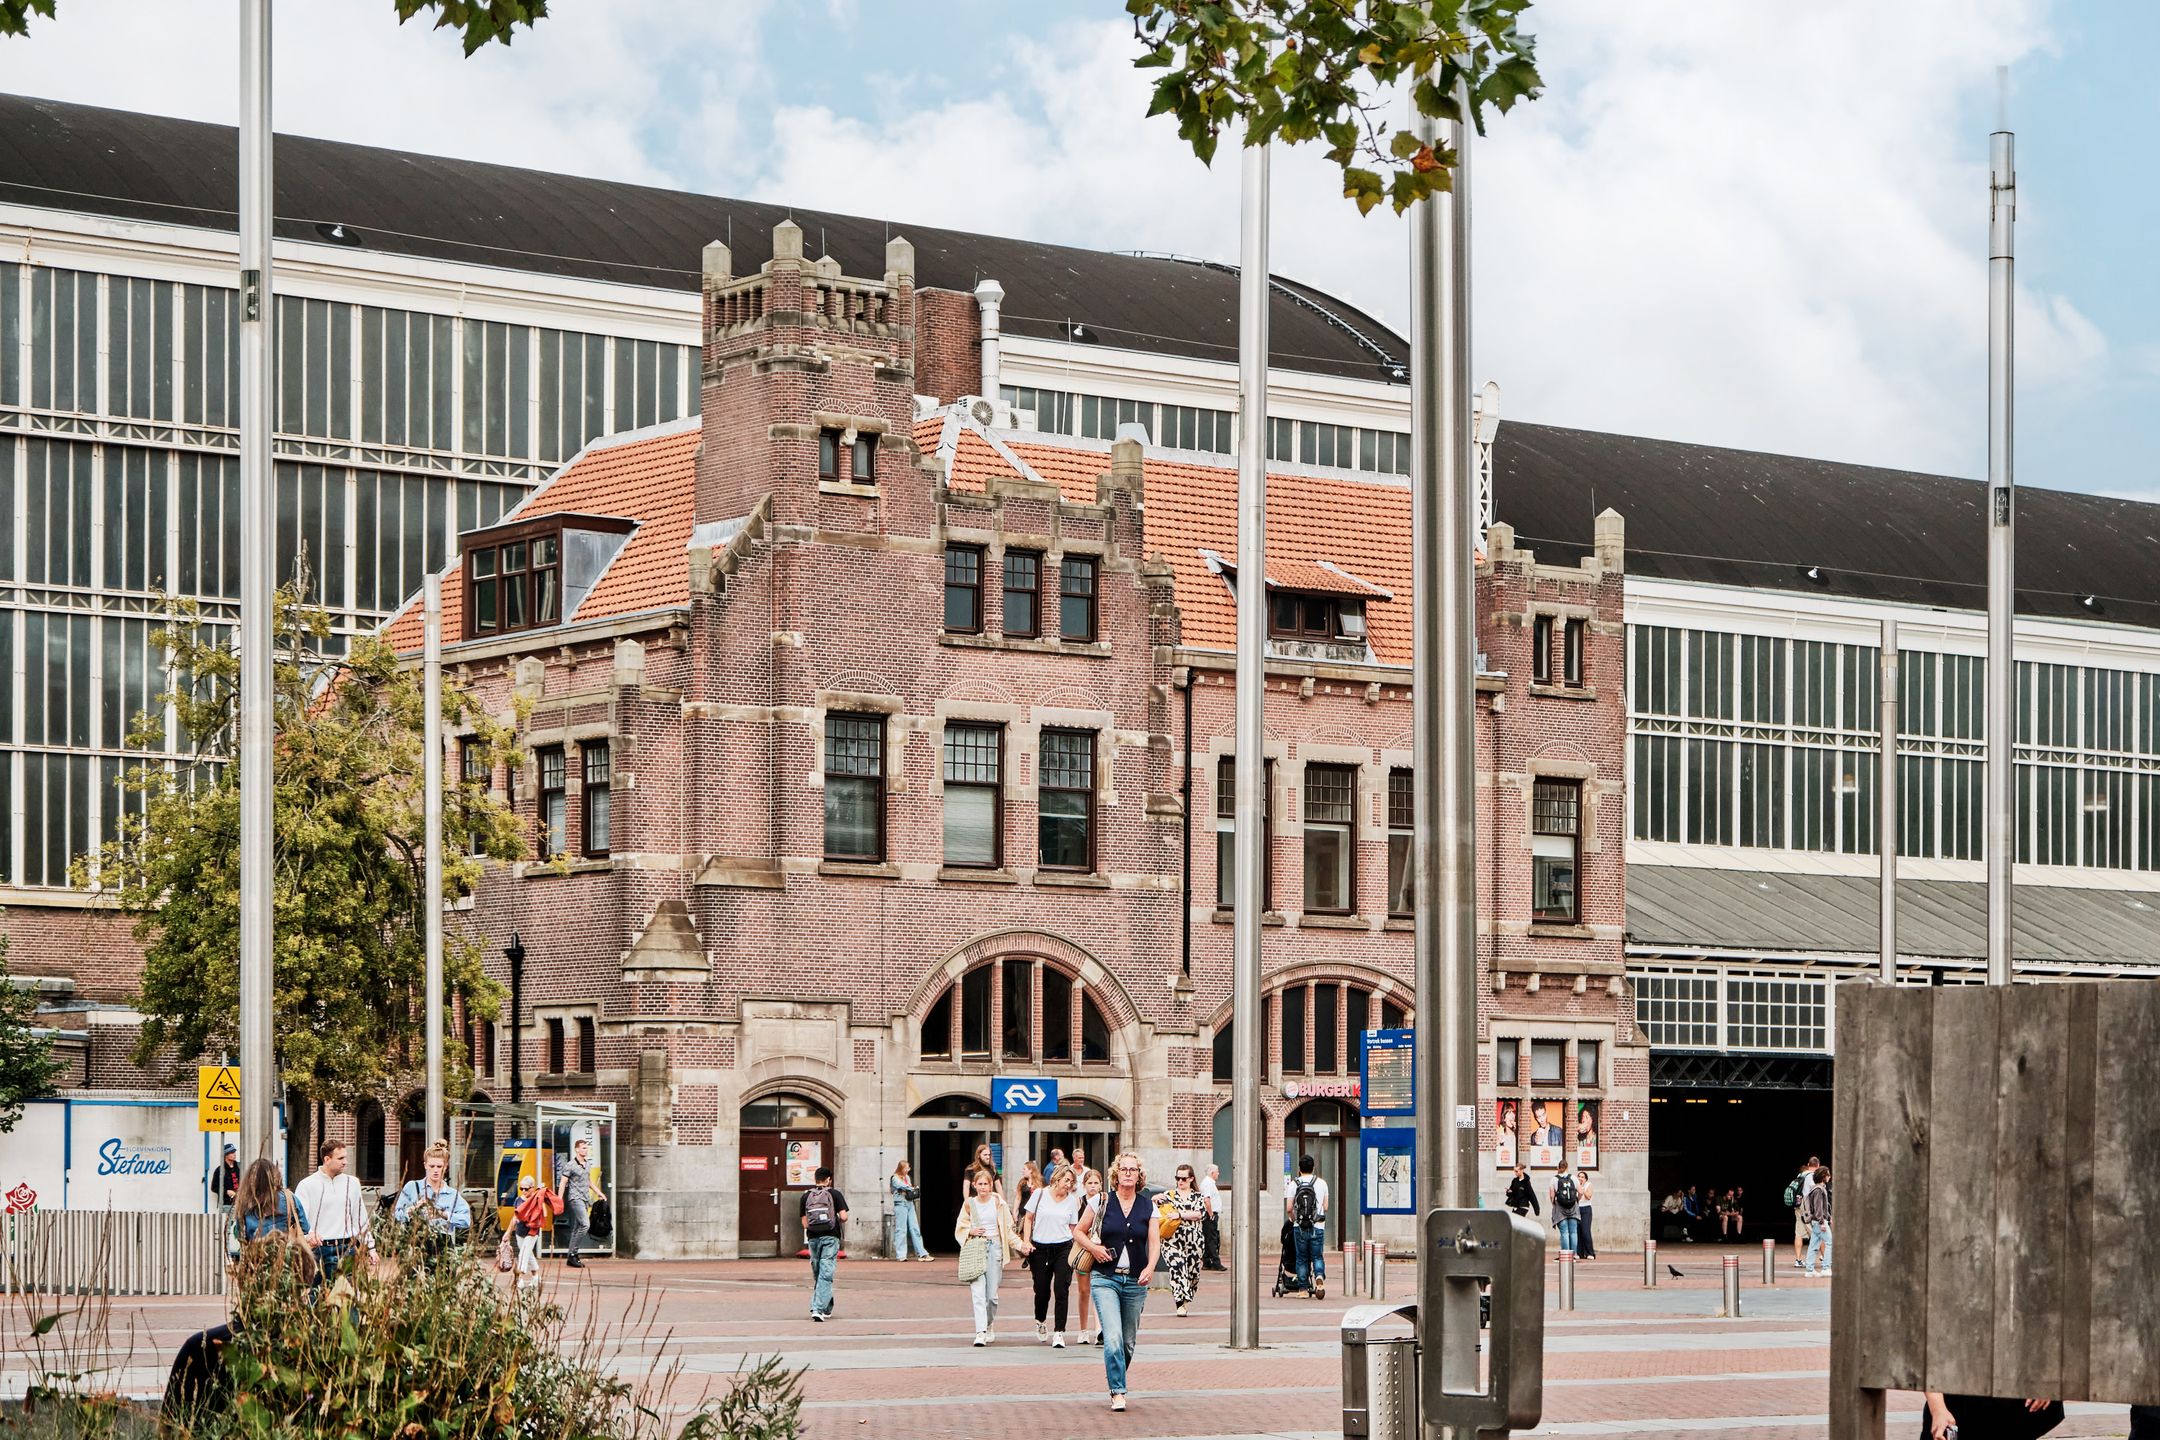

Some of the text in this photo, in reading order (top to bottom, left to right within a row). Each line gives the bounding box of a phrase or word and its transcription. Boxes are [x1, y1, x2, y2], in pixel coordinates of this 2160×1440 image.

[1298, 1083, 1350, 1097] BURGER
[206, 1117, 240, 1125] wegdek
[98, 1138, 169, 1175] Stefano
